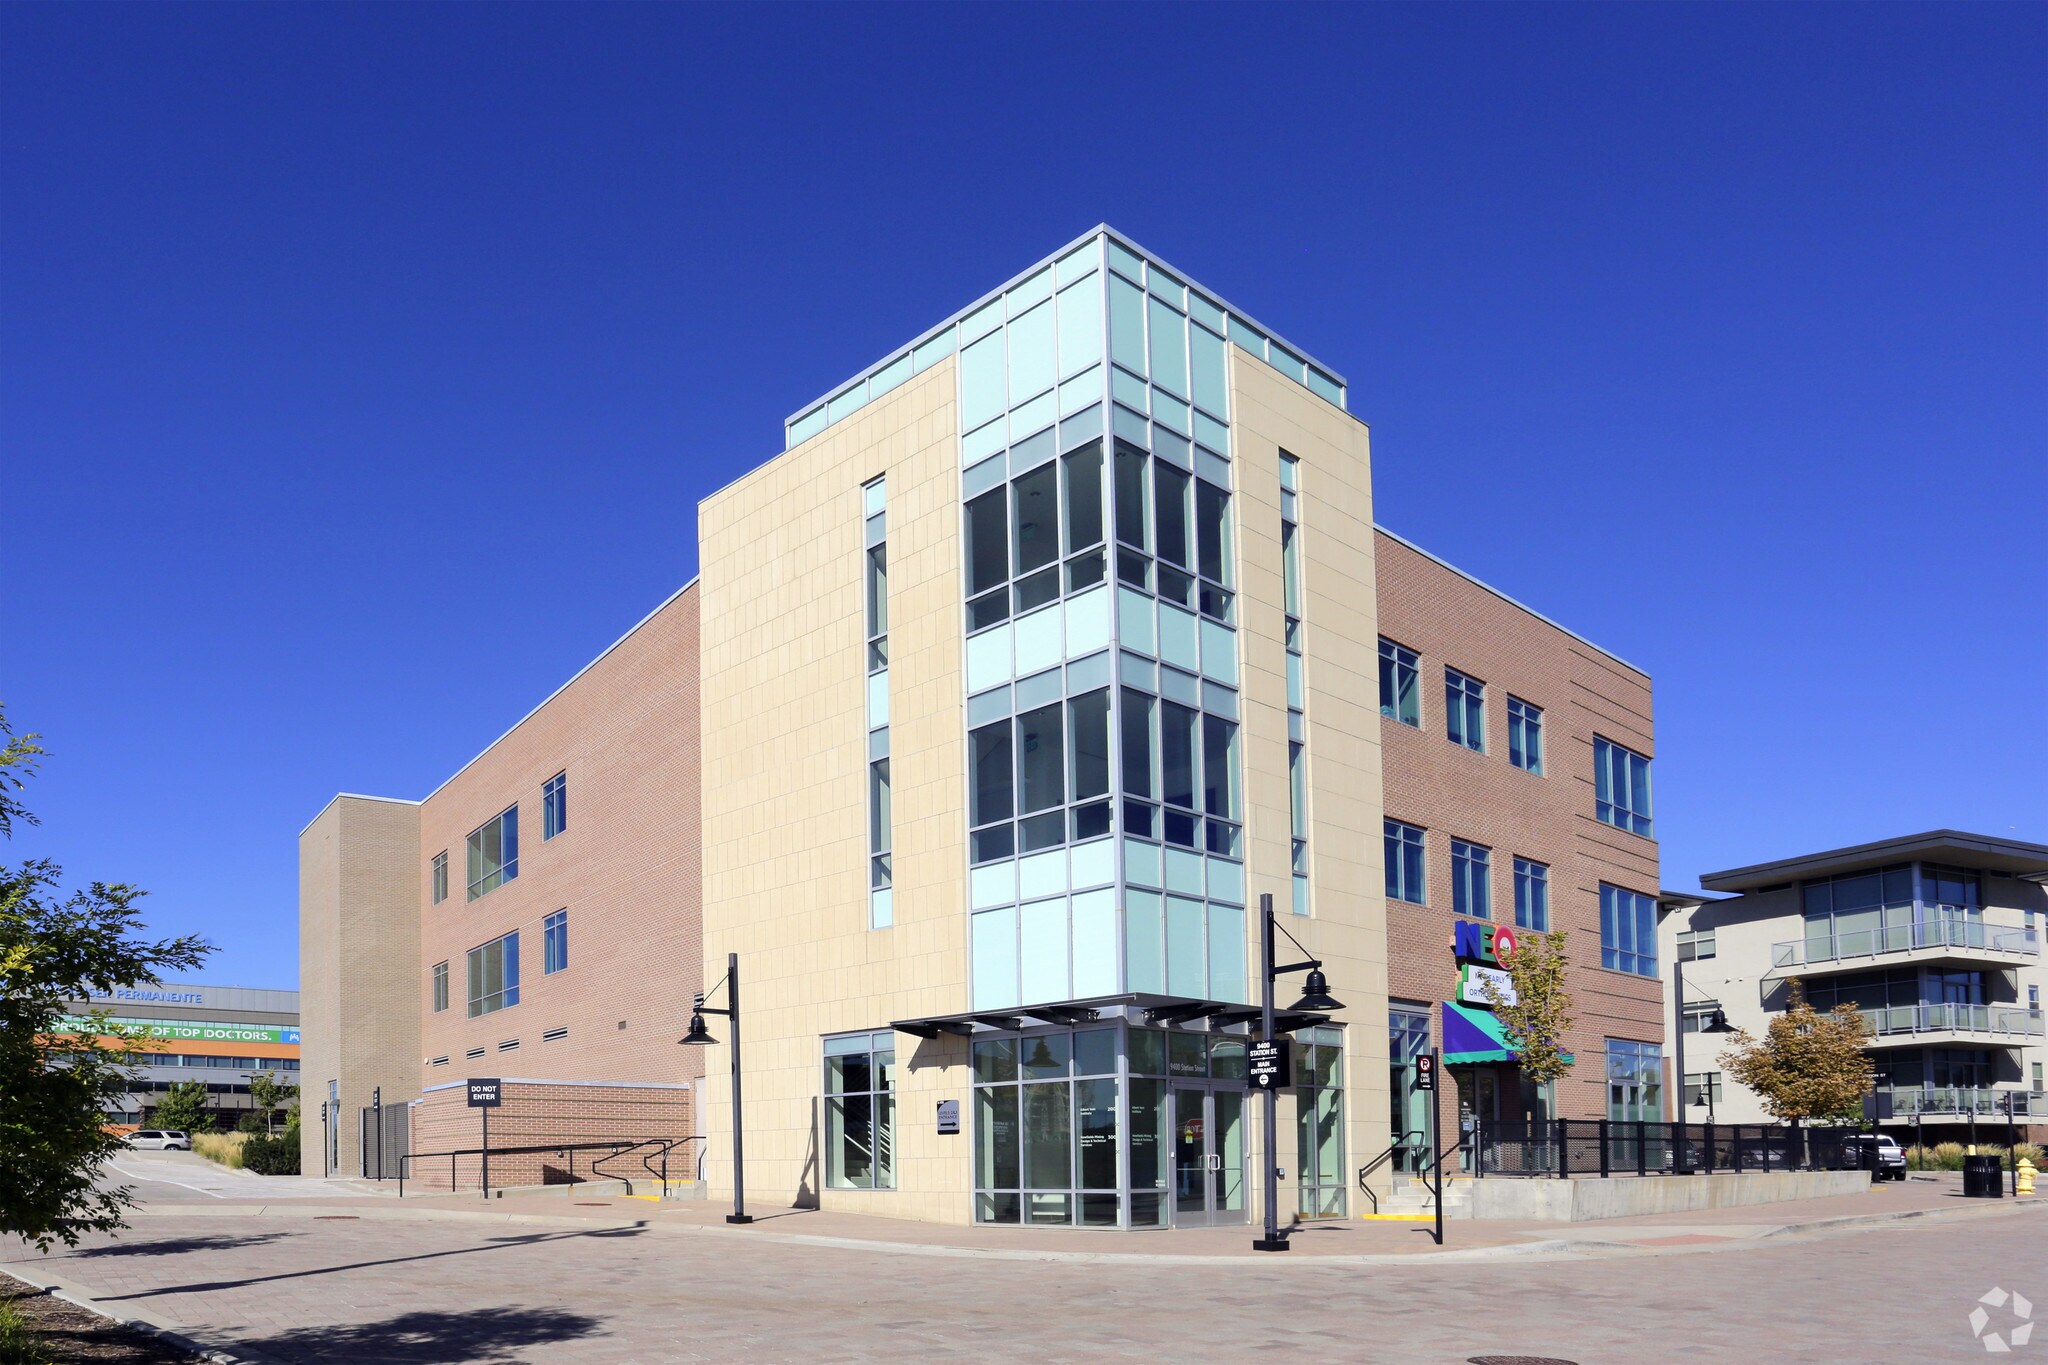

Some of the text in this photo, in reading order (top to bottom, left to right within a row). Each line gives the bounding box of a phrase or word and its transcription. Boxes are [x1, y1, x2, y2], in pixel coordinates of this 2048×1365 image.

[1455, 920, 1517, 970] NEO
[117, 989, 203, 1004] PERMANENTE
[51, 1021, 102, 1034] PROUD
[152, 1027, 170, 1036] OF
[173, 1028, 200, 1038] TOP
[204, 1029, 272, 1041] DOCTORS.
[1250, 1049, 1270, 1057] STATION
